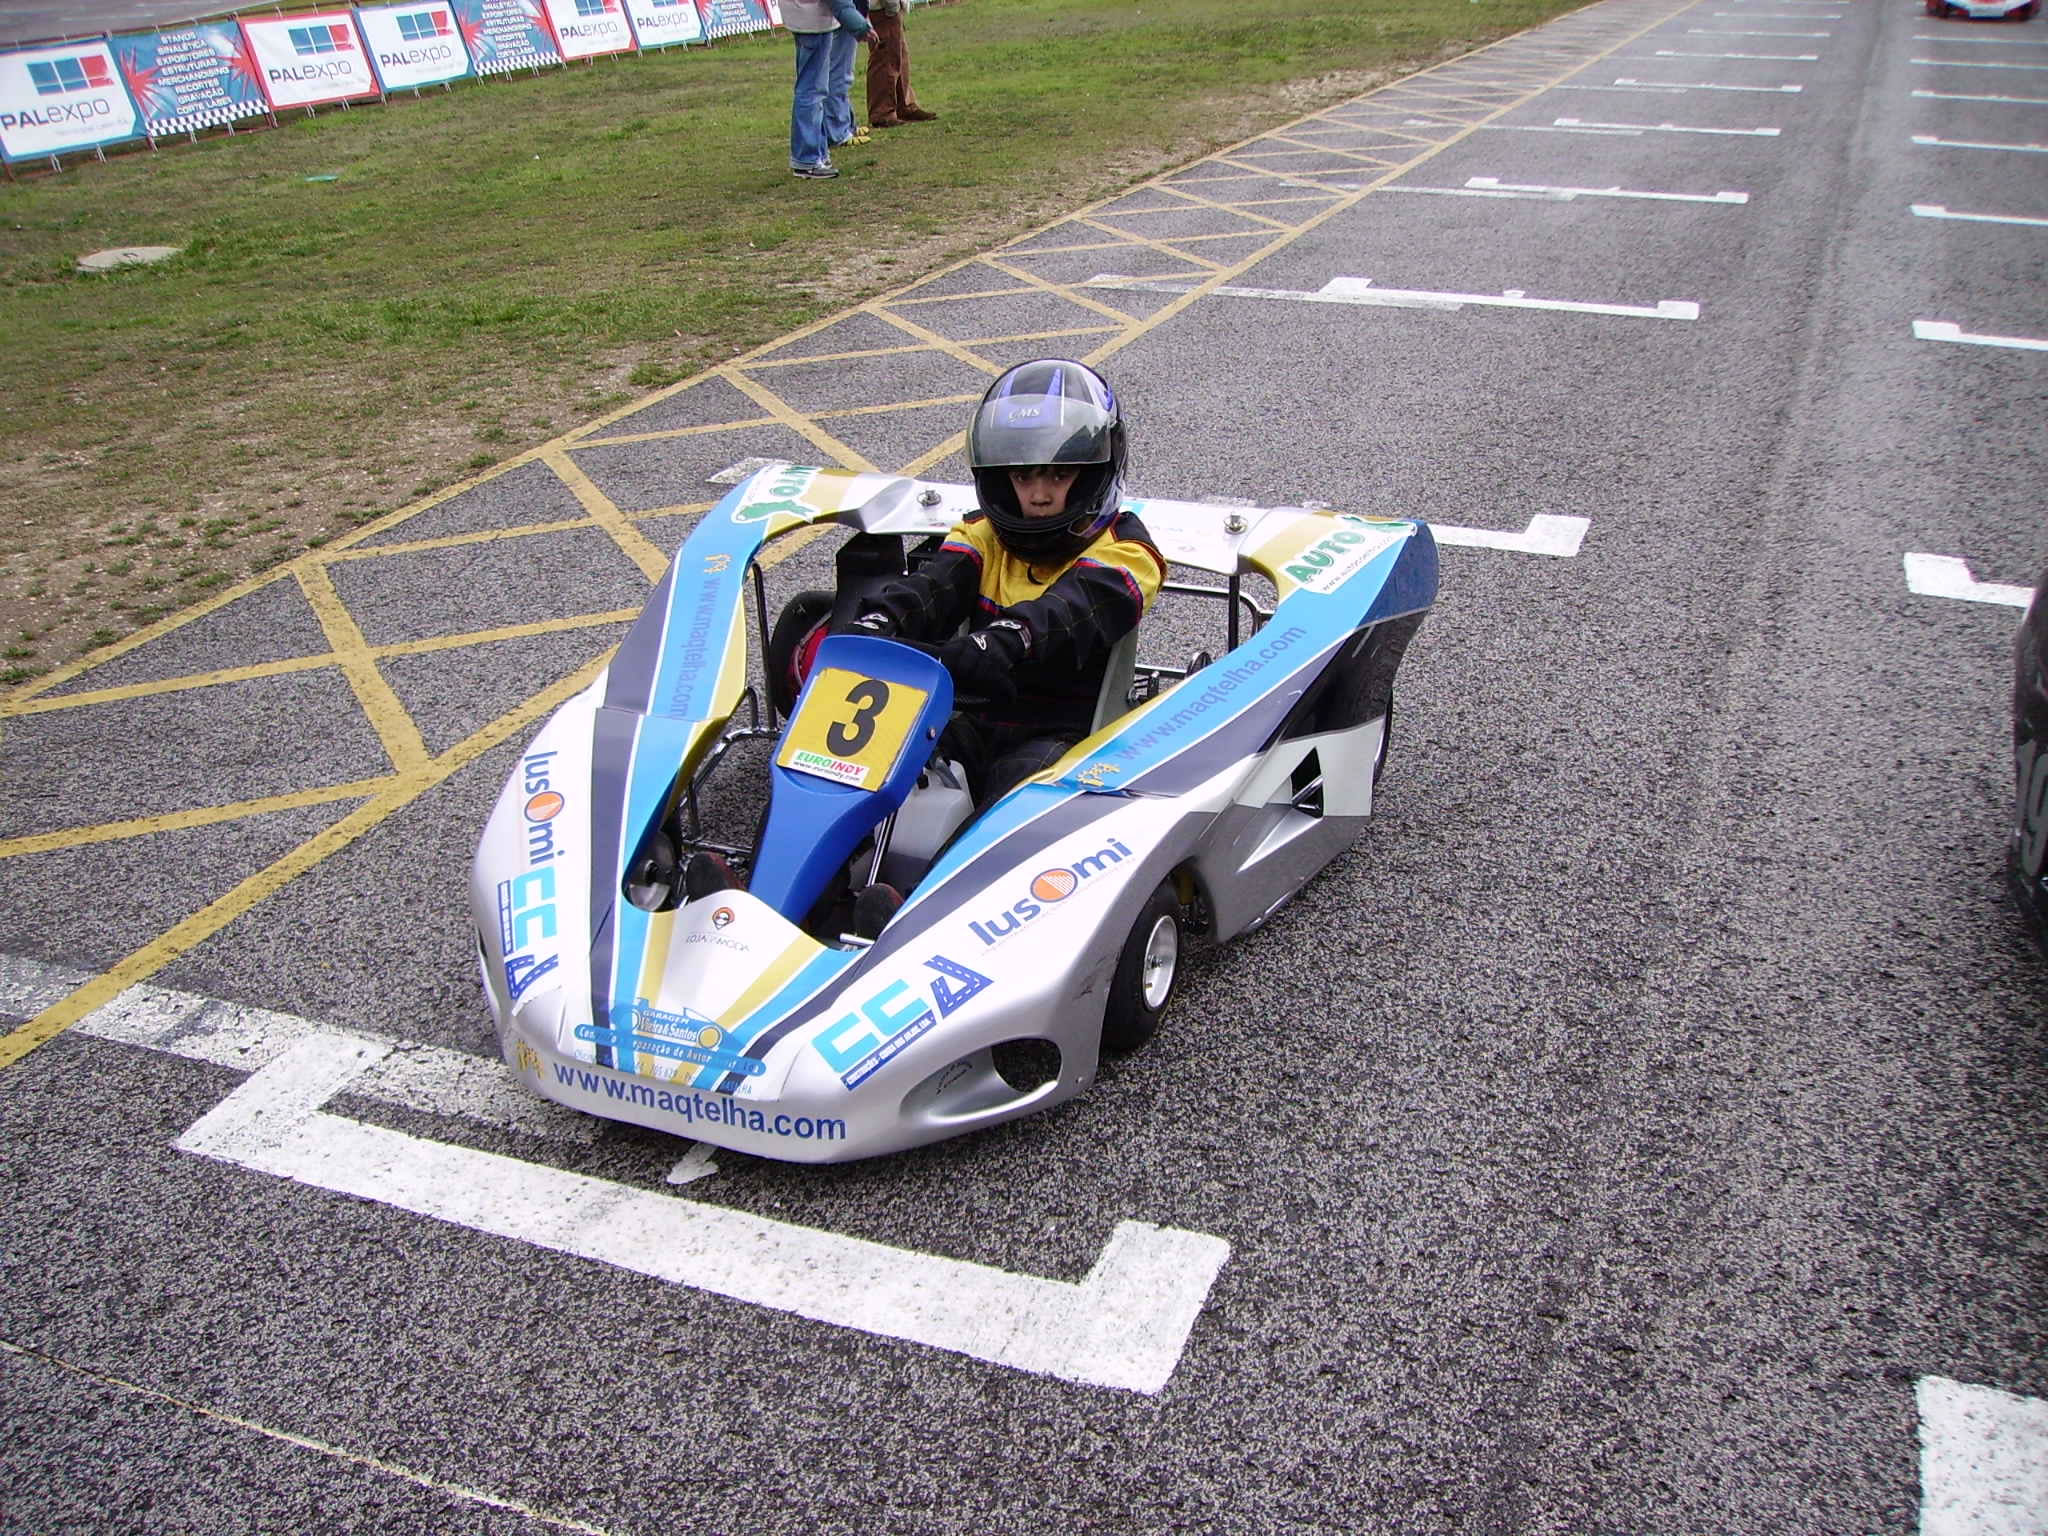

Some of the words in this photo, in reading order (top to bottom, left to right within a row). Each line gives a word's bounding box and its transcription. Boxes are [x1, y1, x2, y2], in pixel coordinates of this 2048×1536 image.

[559, 20, 619, 41] PALexpo
[637, 11, 689, 30] PALexpo
[380, 44, 452, 69] PALexpo
[268, 59, 353, 85] PALexpo
[0, 98, 110, 131] PALexpo
[1284, 530, 1366, 584] AUTO
[1115, 624, 1308, 760] www.maqtelha.com
[826, 679, 890, 757] 3
[796, 751, 865, 776] EUROINDY
[553, 1062, 846, 1140] www.maqtelha.com
